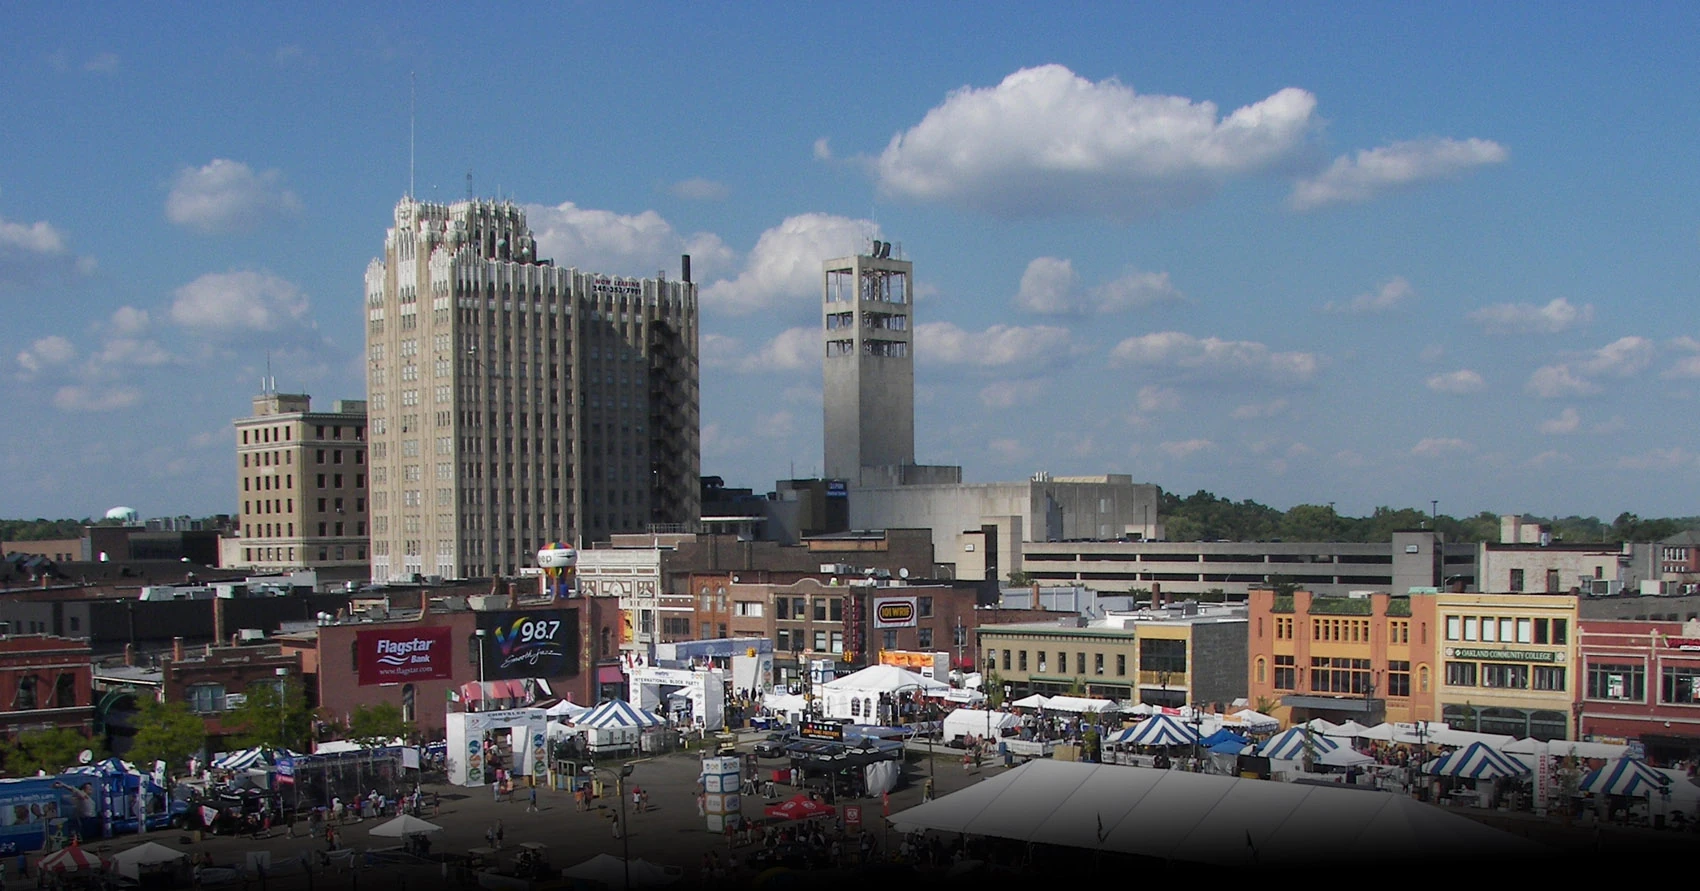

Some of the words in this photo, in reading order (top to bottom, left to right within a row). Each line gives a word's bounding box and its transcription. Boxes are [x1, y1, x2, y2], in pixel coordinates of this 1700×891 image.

[521, 620, 560, 642] 98.7
[377, 638, 432, 655] Flagstar
[411, 654, 430, 663] Bank
[1461, 650, 1489, 658] OAKLAND
[1489, 650, 1524, 659] COMMUNITY
[1524, 651, 1551, 660] COLLEGE
[380, 667, 433, 675] www.flagstar.com
